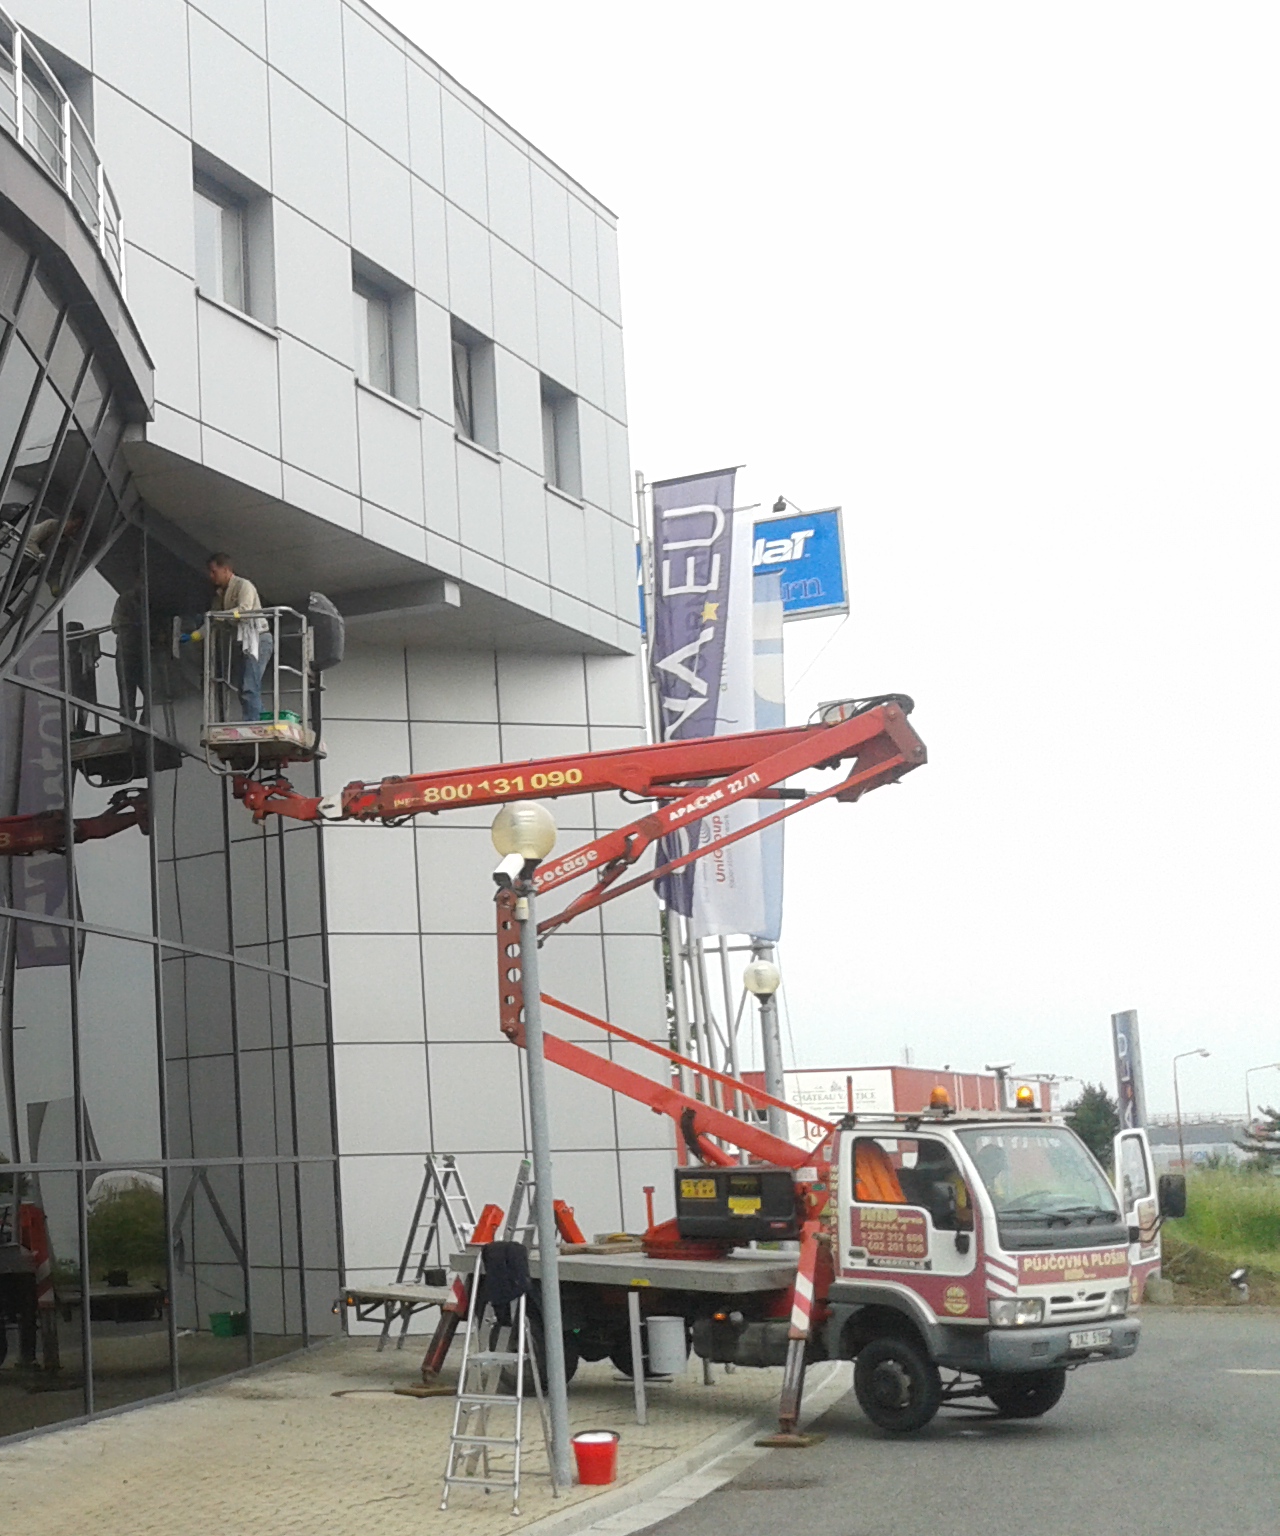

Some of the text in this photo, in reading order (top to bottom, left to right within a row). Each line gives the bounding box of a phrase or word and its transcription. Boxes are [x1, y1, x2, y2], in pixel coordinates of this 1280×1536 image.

[423, 783, 473, 803] 800
[530, 768, 584, 790] 090
[669, 789, 725, 821] APACHE
[533, 849, 598, 887] socage
